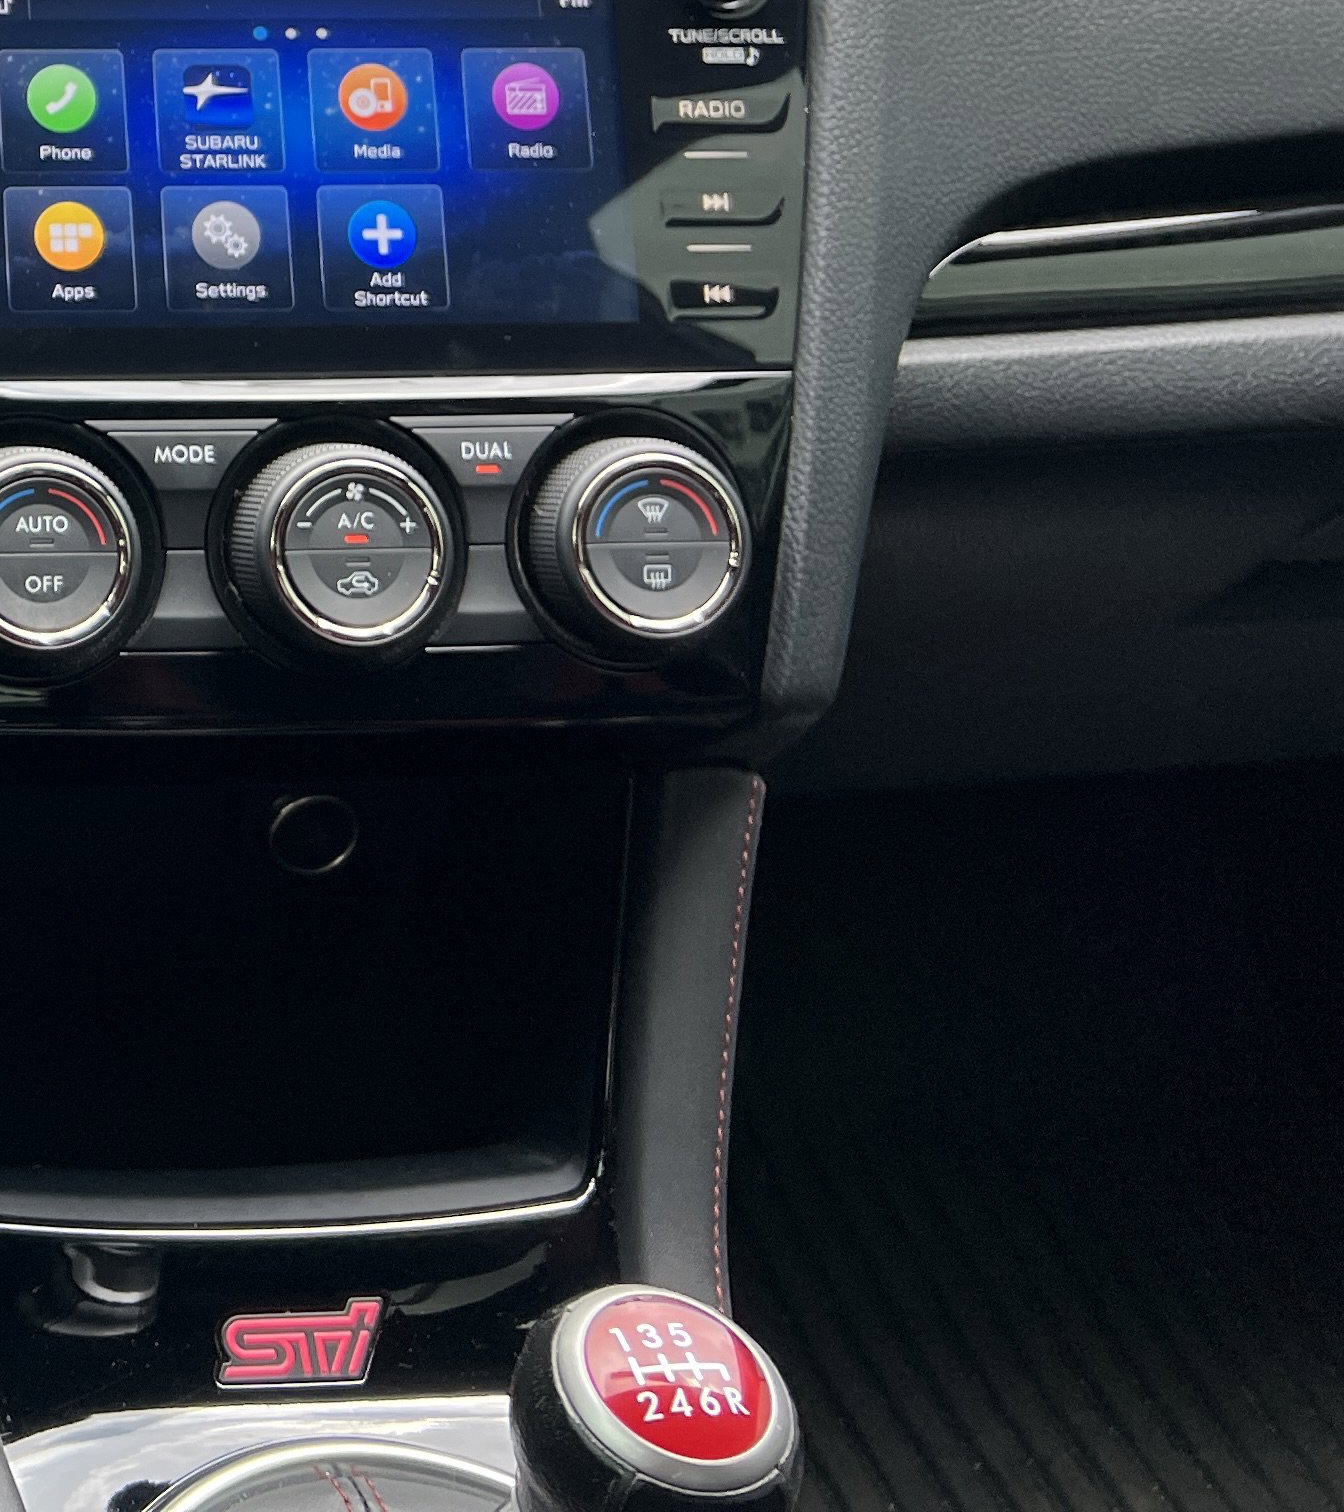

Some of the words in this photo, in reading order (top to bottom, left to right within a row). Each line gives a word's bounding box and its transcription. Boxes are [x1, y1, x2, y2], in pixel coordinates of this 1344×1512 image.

[668, 28, 784, 44] TUNE/SCROLL
[679, 100, 747, 118] RADIO
[186, 135, 259, 151] SUBARU
[354, 144, 402, 159] Media
[509, 143, 556, 159] Radio
[40, 145, 94, 161] Phone
[180, 154, 267, 170] STARLINK
[370, 273, 403, 288] Add
[51, 284, 96, 302] Apps
[196, 282, 267, 302] Settings
[354, 290, 430, 308] Shortcut
[154, 445, 217, 464] MODE
[461, 442, 513, 460] DUAL
[15, 515, 69, 534] AUTO
[337, 512, 375, 531] A/C
[25, 575, 63, 594] OFF
